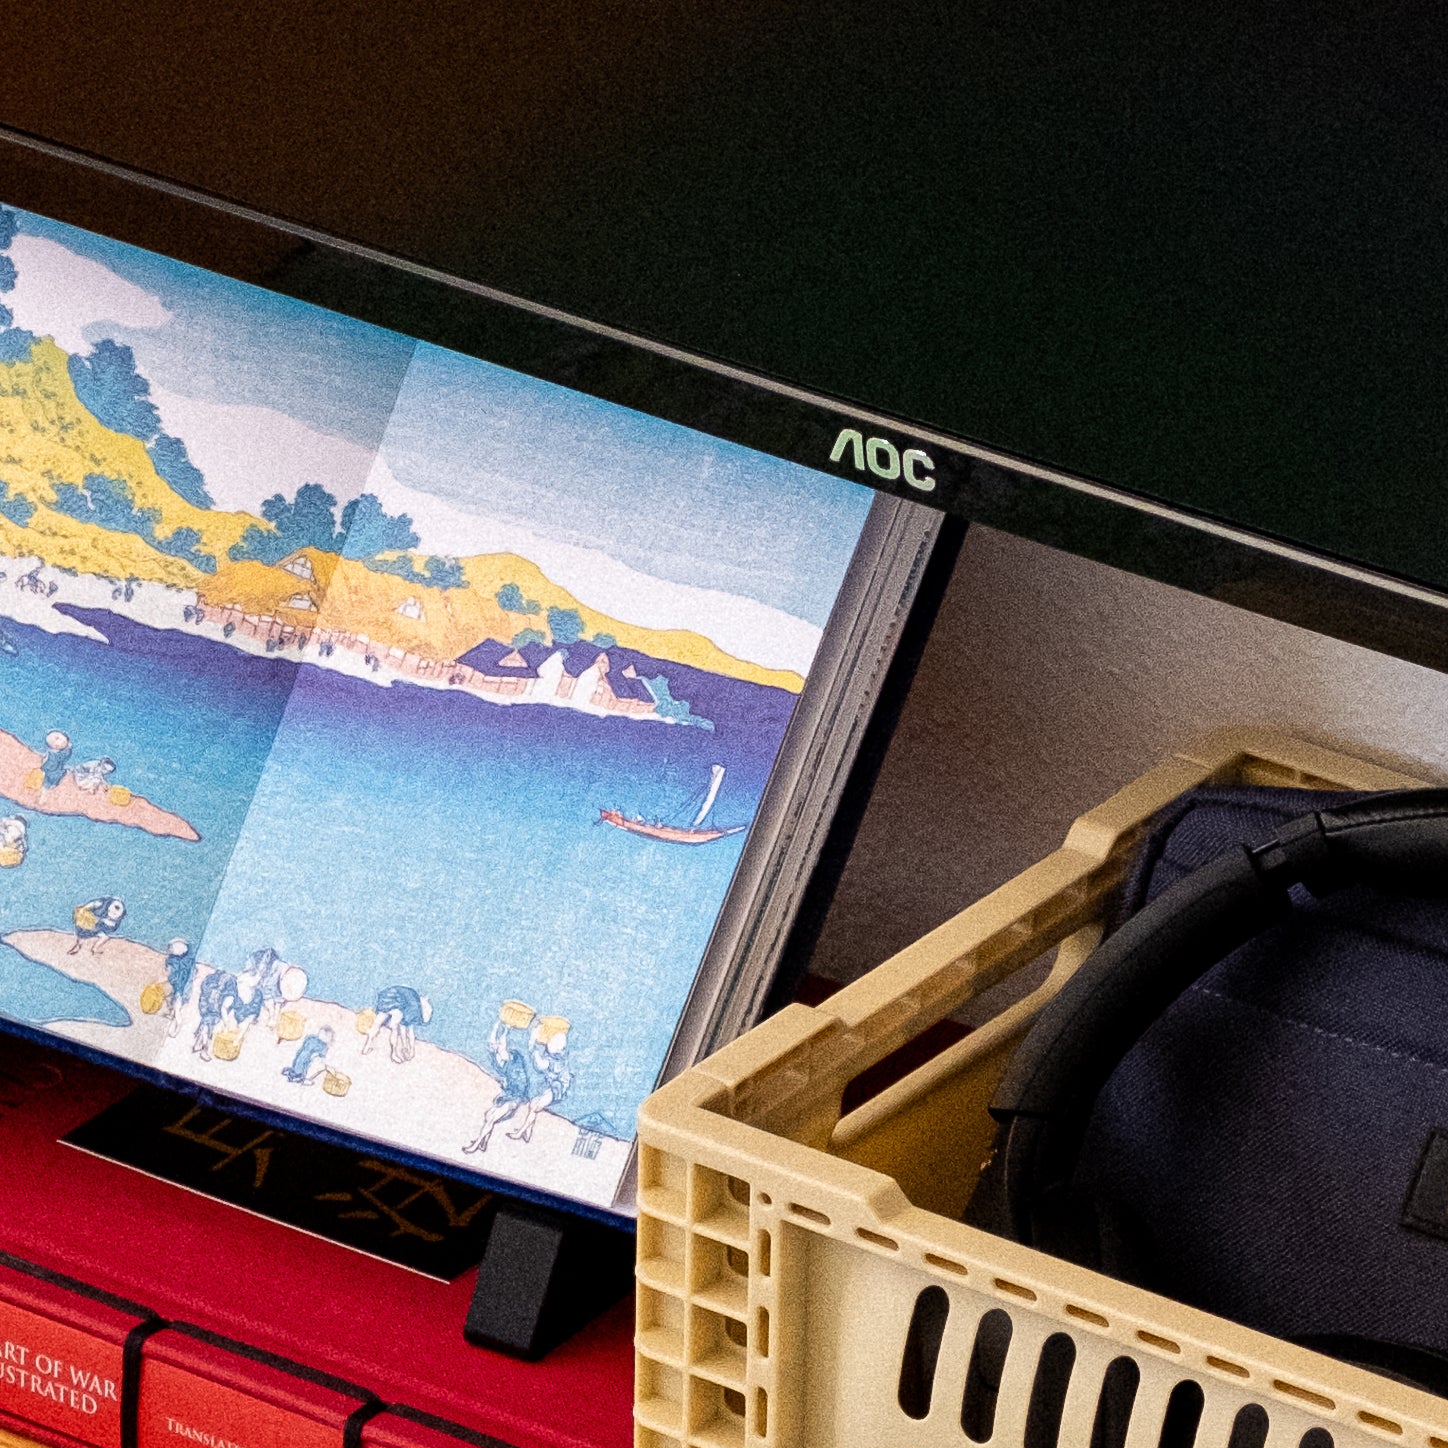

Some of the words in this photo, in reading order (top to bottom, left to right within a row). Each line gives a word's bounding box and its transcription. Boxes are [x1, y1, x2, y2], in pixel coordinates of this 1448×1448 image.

[829, 428, 936, 492] AOC
[0, 1340, 29, 1365] RT
[36, 1354, 62, 1378] OF
[70, 1365, 118, 1401] WAR
